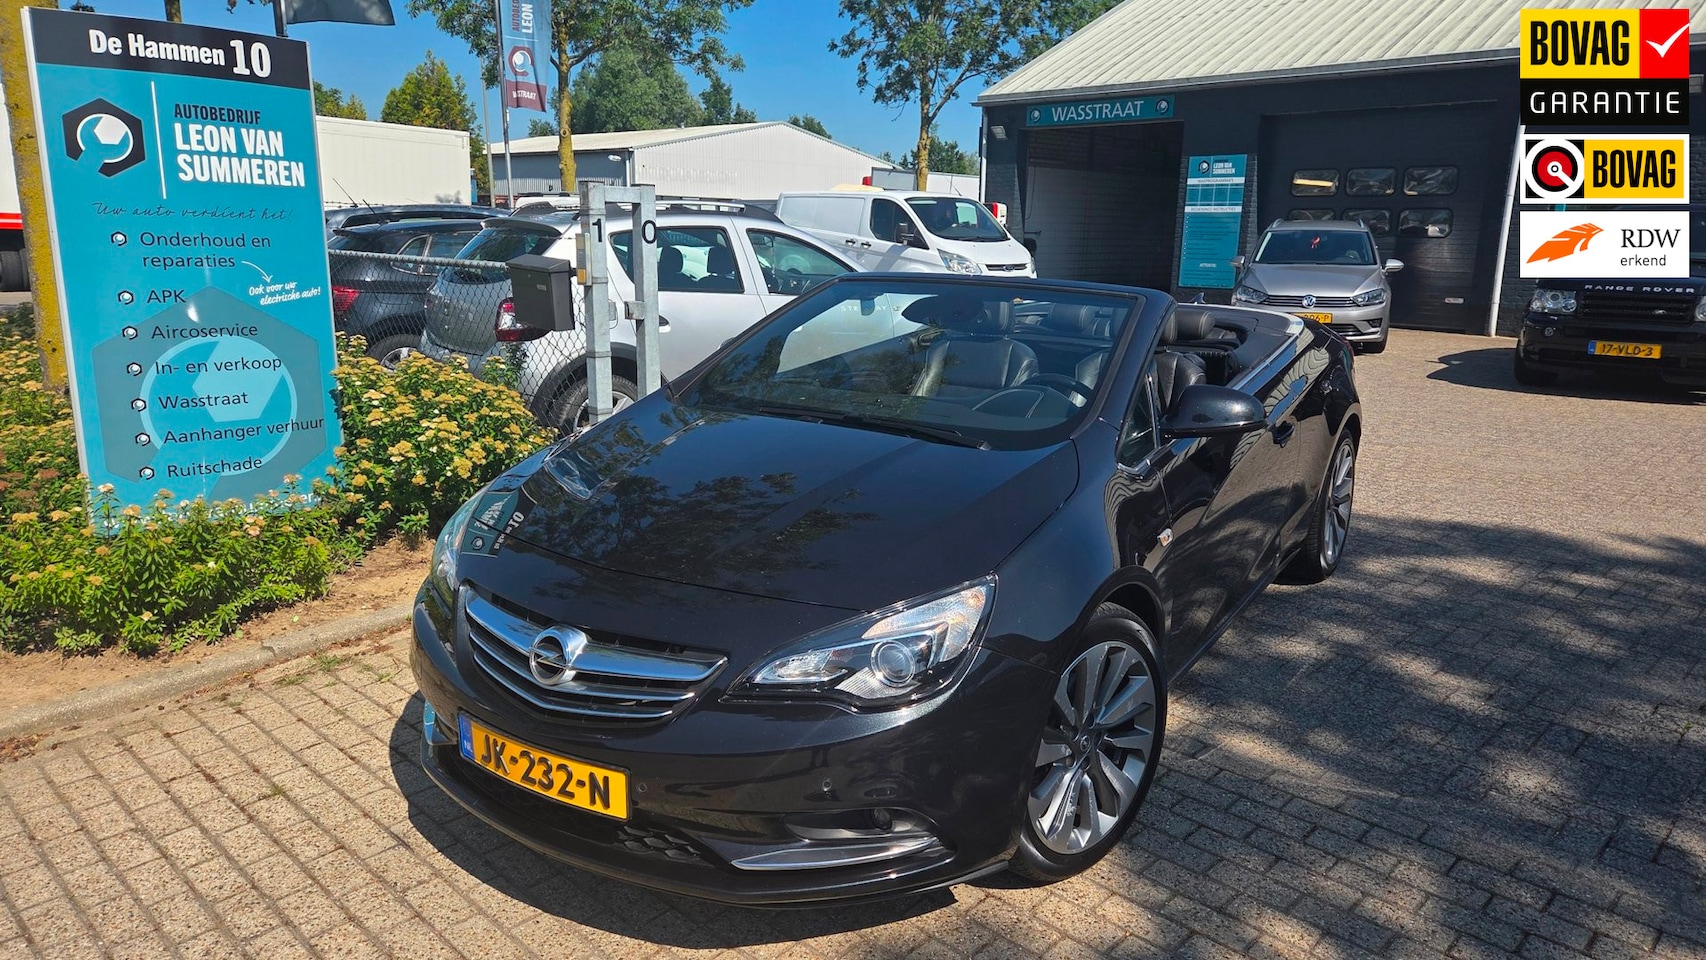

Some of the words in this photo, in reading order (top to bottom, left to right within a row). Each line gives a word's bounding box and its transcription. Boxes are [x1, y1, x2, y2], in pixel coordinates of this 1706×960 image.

[521, 3, 534, 34] LEON
[89, 29, 122, 55] De
[128, 33, 225, 66] Hammen
[229, 39, 272, 78] 10
[174, 103, 261, 125] AUTOBEDRIJF
[1051, 100, 1144, 122] WASSTRAAT
[174, 122, 237, 153] LEON
[241, 128, 284, 157] VAN
[176, 153, 305, 187] SUMMEREN
[91, 202, 127, 215] Uw
[132, 204, 175, 217] auto
[181, 206, 256, 220] verdient
[261, 207, 294, 220] het!
[140, 231, 245, 248] Onderhoud
[251, 236, 271, 248] en
[592, 218, 603, 243] 1
[143, 253, 235, 271] reparaties
[147, 289, 186, 304] APK
[249, 284, 264, 296] Ook
[266, 284, 284, 293] voor
[285, 281, 298, 290] uw
[260, 290, 300, 305] electrische
[301, 286, 321, 298] auto!
[151, 324, 258, 339] Aircoservice
[1602, 344, 1653, 356] 17-VLD-3
[155, 361, 180, 375] In-
[185, 361, 209, 373] en
[214, 356, 282, 371] verkoop
[158, 392, 249, 410] Wasstraat
[164, 424, 263, 444] Aanhanger
[267, 417, 324, 436] verhuur
[167, 456, 263, 478] Ruitschade
[481, 734, 610, 810] JK-232-N
